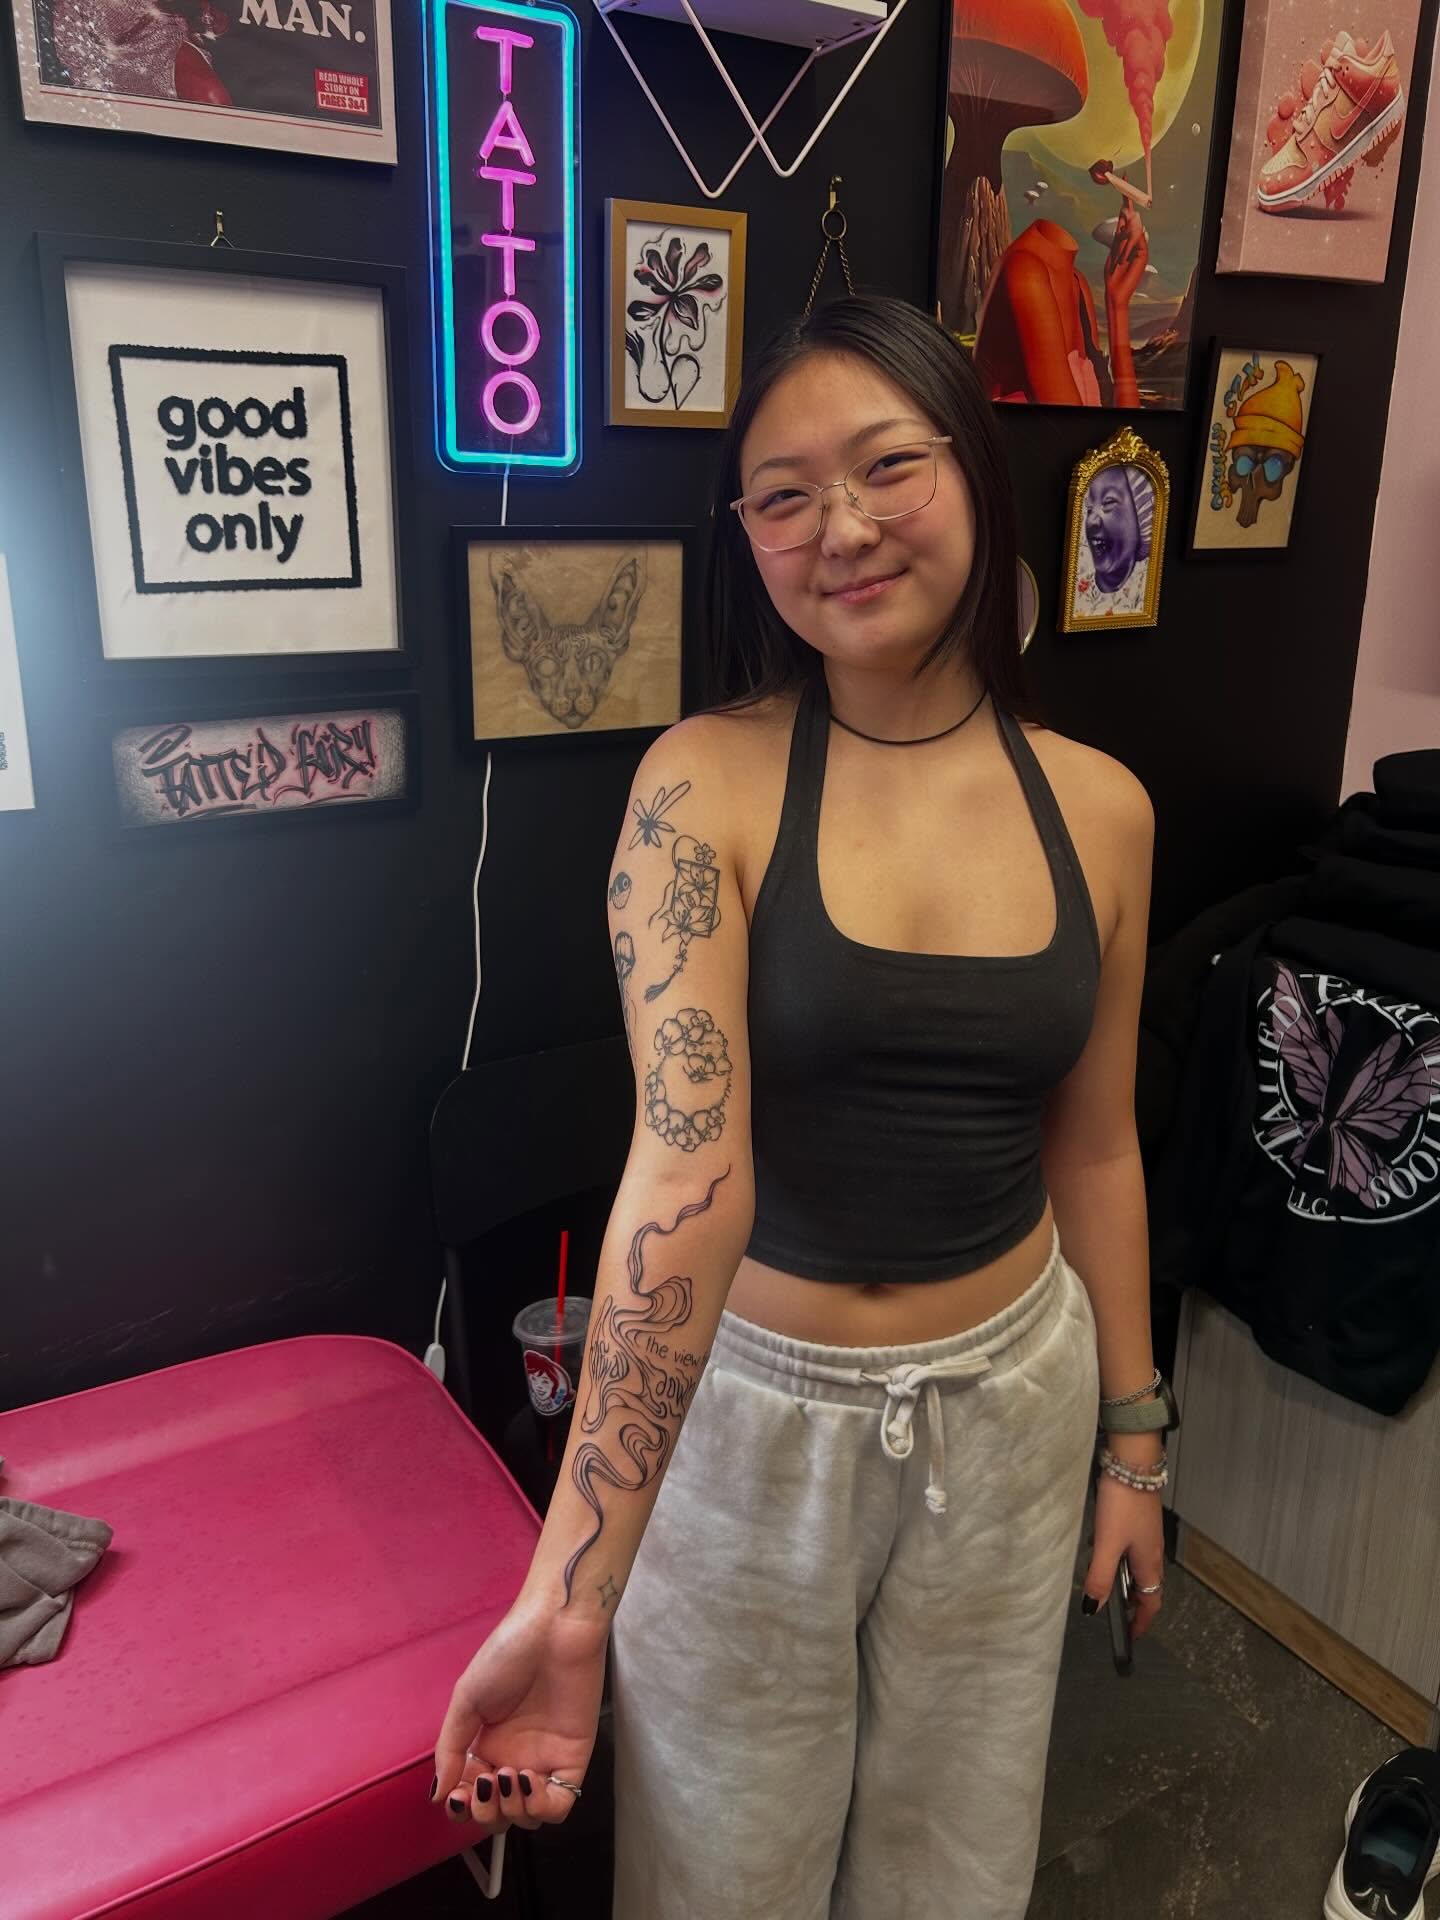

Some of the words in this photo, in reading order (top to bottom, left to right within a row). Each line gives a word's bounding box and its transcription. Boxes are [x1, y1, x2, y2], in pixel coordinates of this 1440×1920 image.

[239, 0, 366, 43] MAN.
[318, 71, 338, 83] READ
[339, 74, 364, 87] WHOLE
[320, 93, 347, 107] PAGES
[324, 82, 347, 95] STORY
[349, 86, 360, 96] ON
[475, 25, 541, 435] TATTOO
[157, 386, 308, 450] good
[164, 442, 312, 496] vibes
[185, 500, 304, 563] only
[1315, 974, 1440, 1032] FRY
[1369, 1052, 1440, 1209] TTTOOS
[645, 1335, 669, 1359] the
[674, 1348, 701, 1367] view
